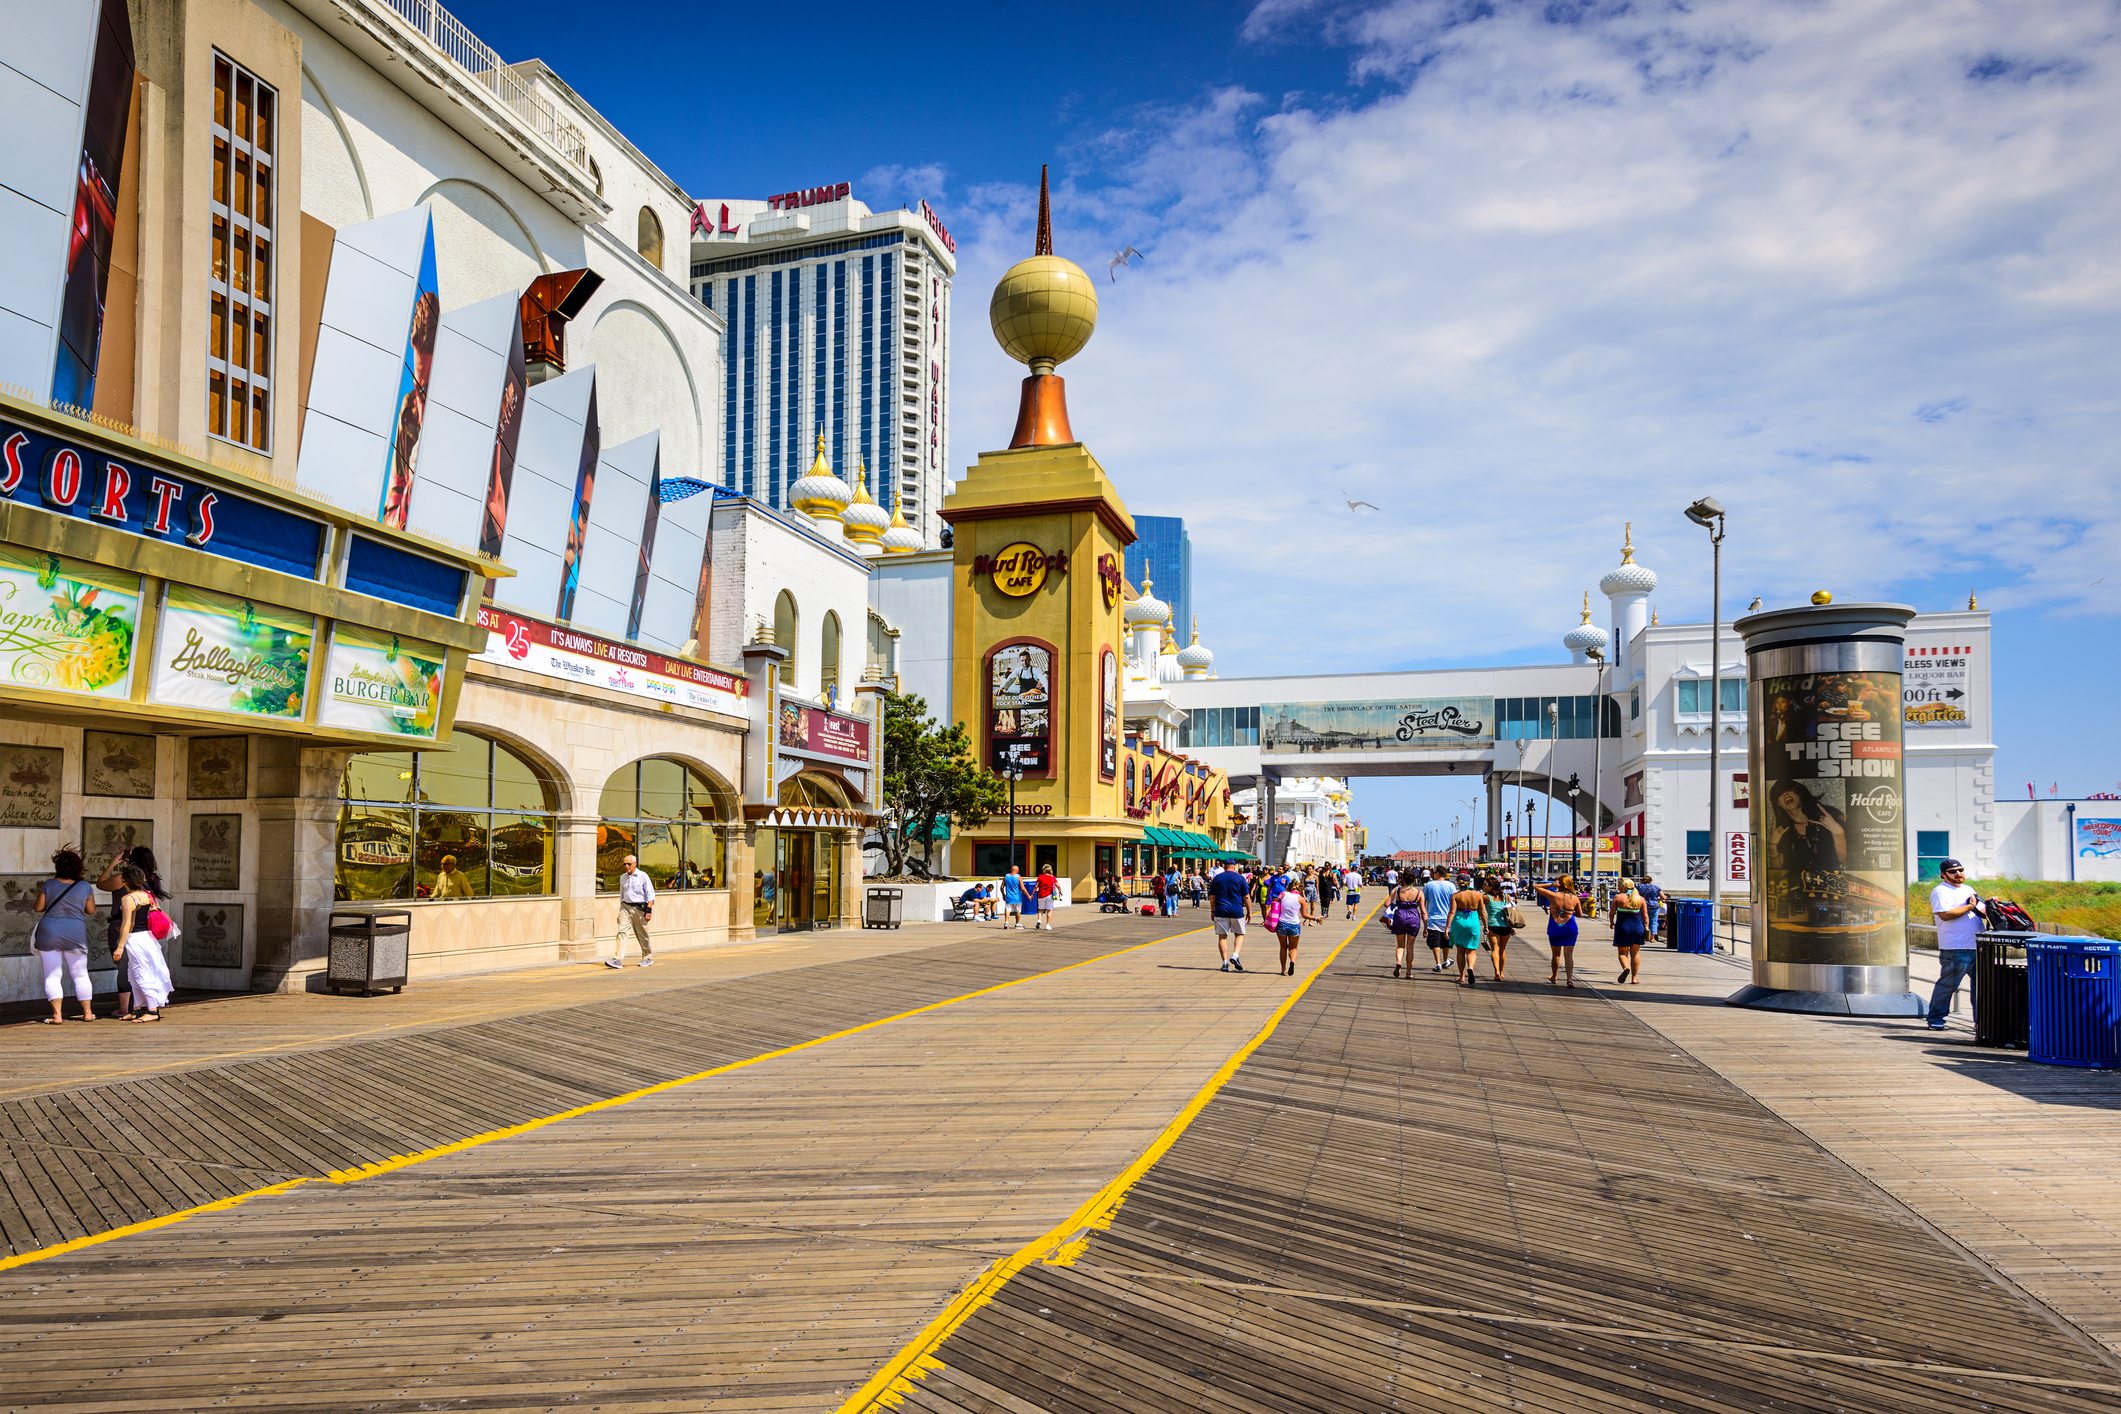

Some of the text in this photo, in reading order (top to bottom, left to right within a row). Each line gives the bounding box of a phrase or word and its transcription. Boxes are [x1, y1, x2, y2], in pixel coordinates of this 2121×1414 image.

[768, 182, 851, 211] TRUMP
[921, 199, 957, 254] TRUMP
[931, 277, 940, 469] TAJ MAHAL
[0, 431, 219, 546] SORTS
[974, 549, 1069, 576] Hard Rock
[1007, 576, 1034, 588] CAFE
[489, 614, 500, 629] AT
[506, 620, 531, 660] 25
[550, 629, 647, 668] IT'S ALWAYS LIVE AT RESORTS!
[170, 627, 295, 688] Gallagher's
[550, 657, 562, 669] The
[1935, 658, 1966, 668] VIEWS
[187, 669, 275, 691] Steak House Since 1927
[348, 662, 391, 685] Gallagher's
[665, 661, 733, 690] DAILY LIVE ENTERTAINMENT
[1908, 671, 1946, 680] LIQUOR
[334, 677, 431, 708] BURGER BAR
[1768, 674, 1815, 694] Hard
[1927, 688, 1942, 702] ft
[1336, 705, 1375, 713] SHOWPLACE
[1396, 709, 1440, 739] Steel
[1816, 722, 1882, 741] SEE
[1010, 743, 1032, 752] SEE
[1784, 741, 1852, 761] THE
[1861, 746, 1893, 754] ATLANTIC
[1817, 759, 1896, 778] SHOW
[1014, 804, 1053, 815] SHOP
[1850, 793, 1885, 807] Hard
[2092, 829, 2113, 837] TOURS
[1559, 840, 1565, 848] &
[1566, 840, 1582, 848] HT
[1731, 833, 1746, 880] ARCADE
